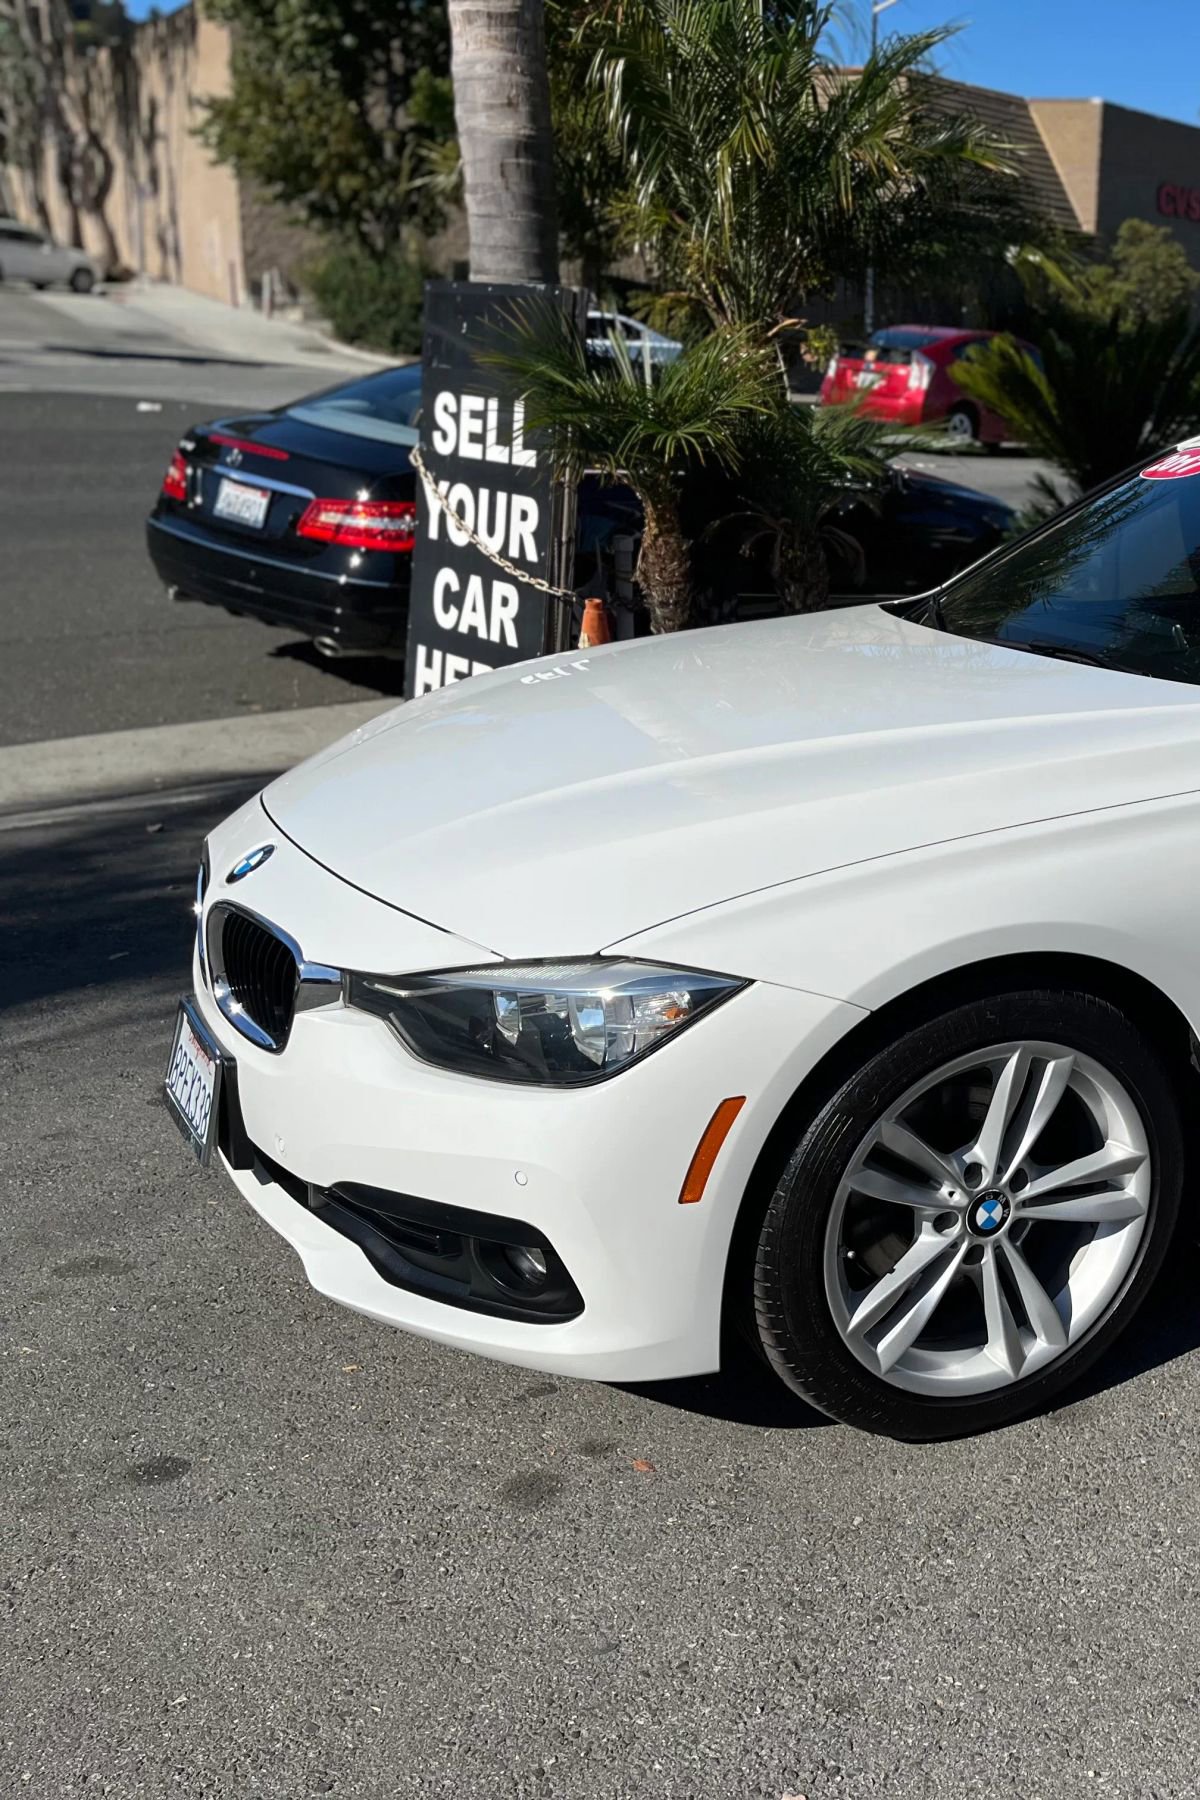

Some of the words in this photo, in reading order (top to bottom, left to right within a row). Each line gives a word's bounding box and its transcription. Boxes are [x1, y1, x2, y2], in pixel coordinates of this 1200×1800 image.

[432, 390, 537, 468] SELL
[423, 480, 539, 563] YOUR
[433, 567, 519, 648] CAR
[414, 644, 496, 698] HE
